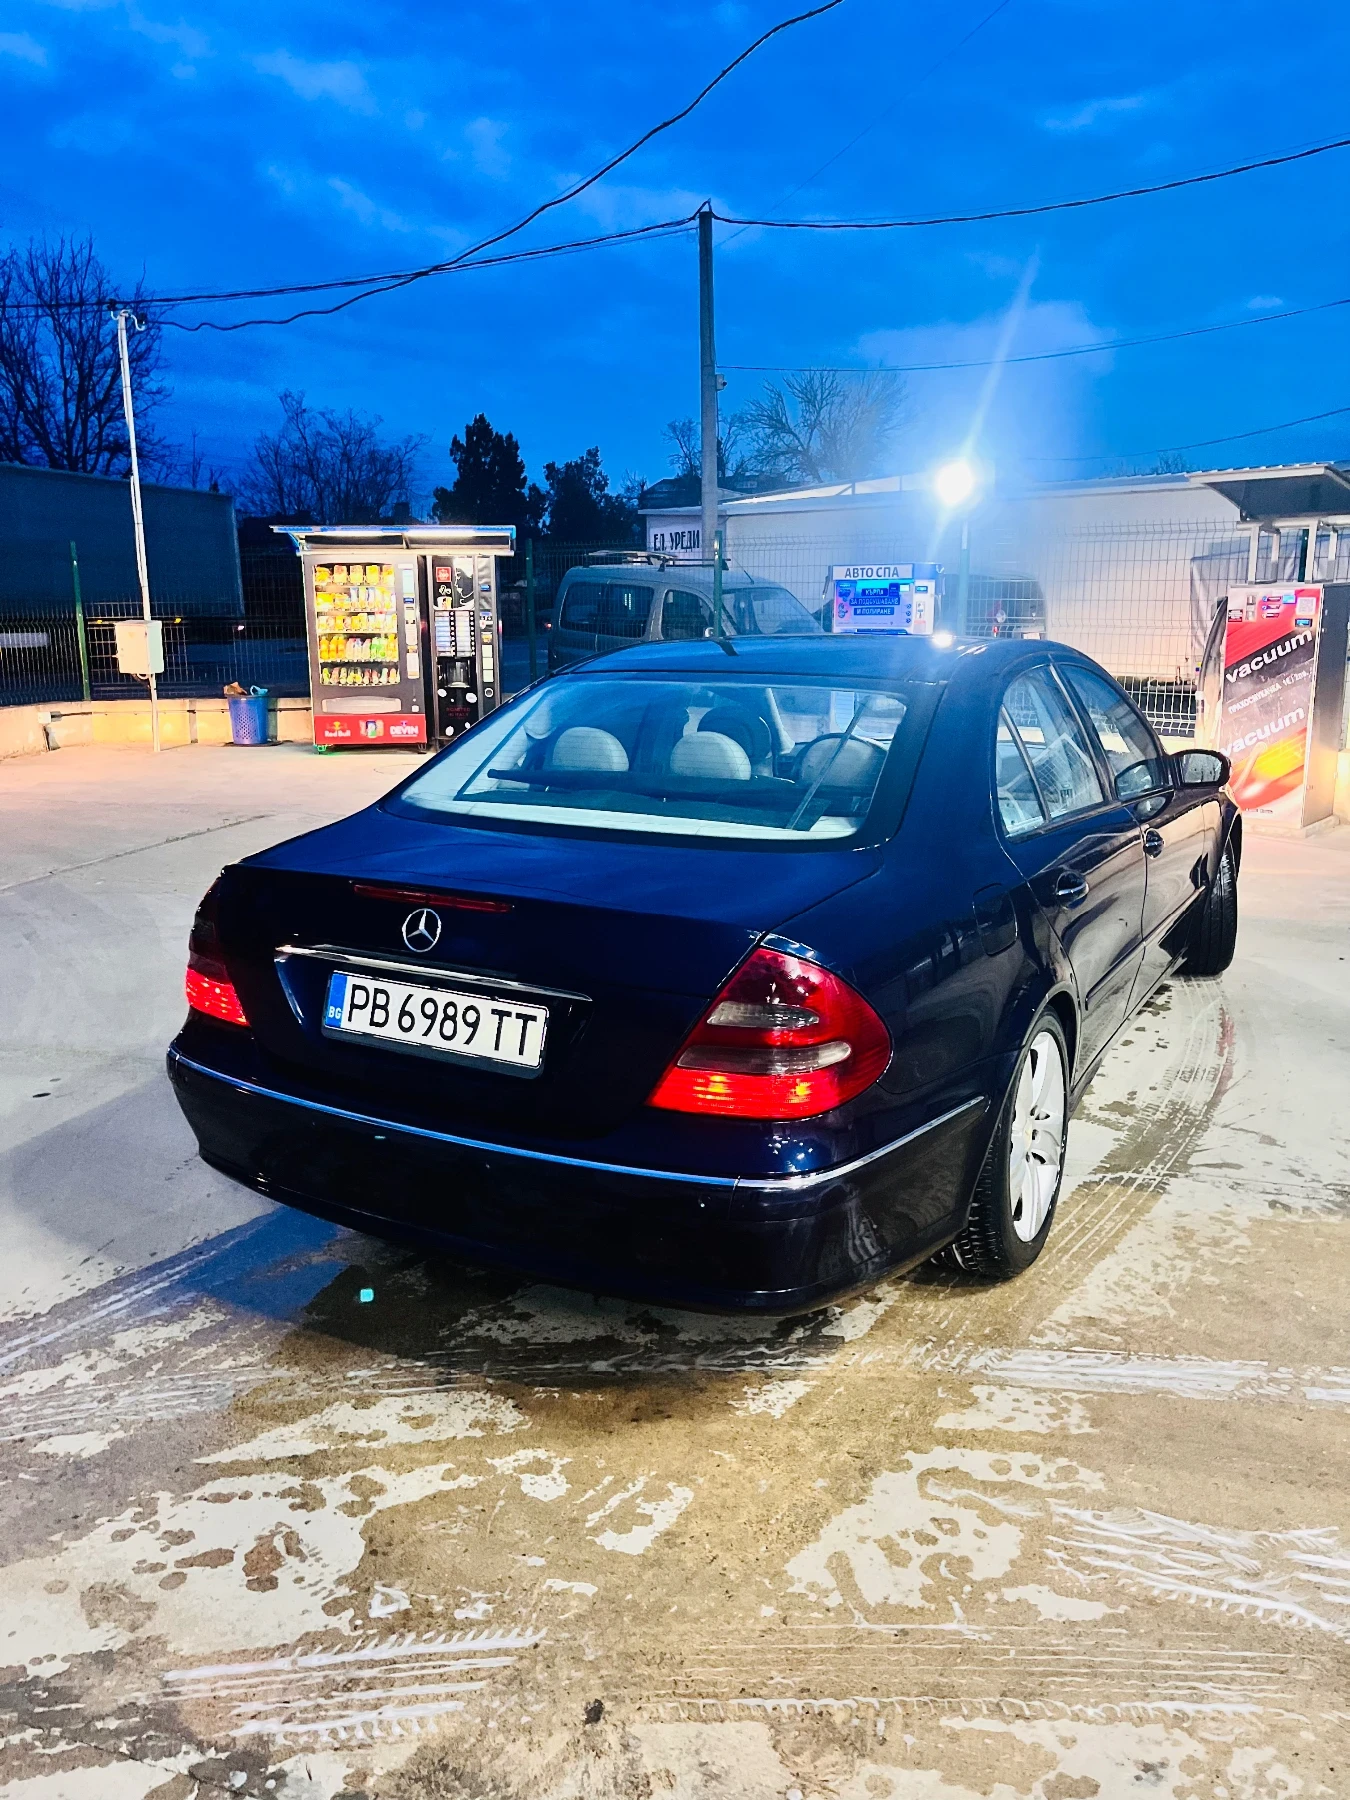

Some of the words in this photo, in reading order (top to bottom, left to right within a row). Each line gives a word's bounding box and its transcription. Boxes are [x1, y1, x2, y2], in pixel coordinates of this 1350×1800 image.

[669, 529, 700, 553] УРЕДИ
[844, 567, 874, 579] АВТО
[875, 566, 900, 578] СПА
[1225, 629, 1313, 684] vacuum
[389, 725, 419, 735] DEVIN
[1220, 707, 1306, 757] vacuum
[328, 1005, 342, 1020] BG
[347, 983, 391, 1028] PB
[397, 993, 481, 1046] 6989
[490, 1008, 538, 1056] TT
